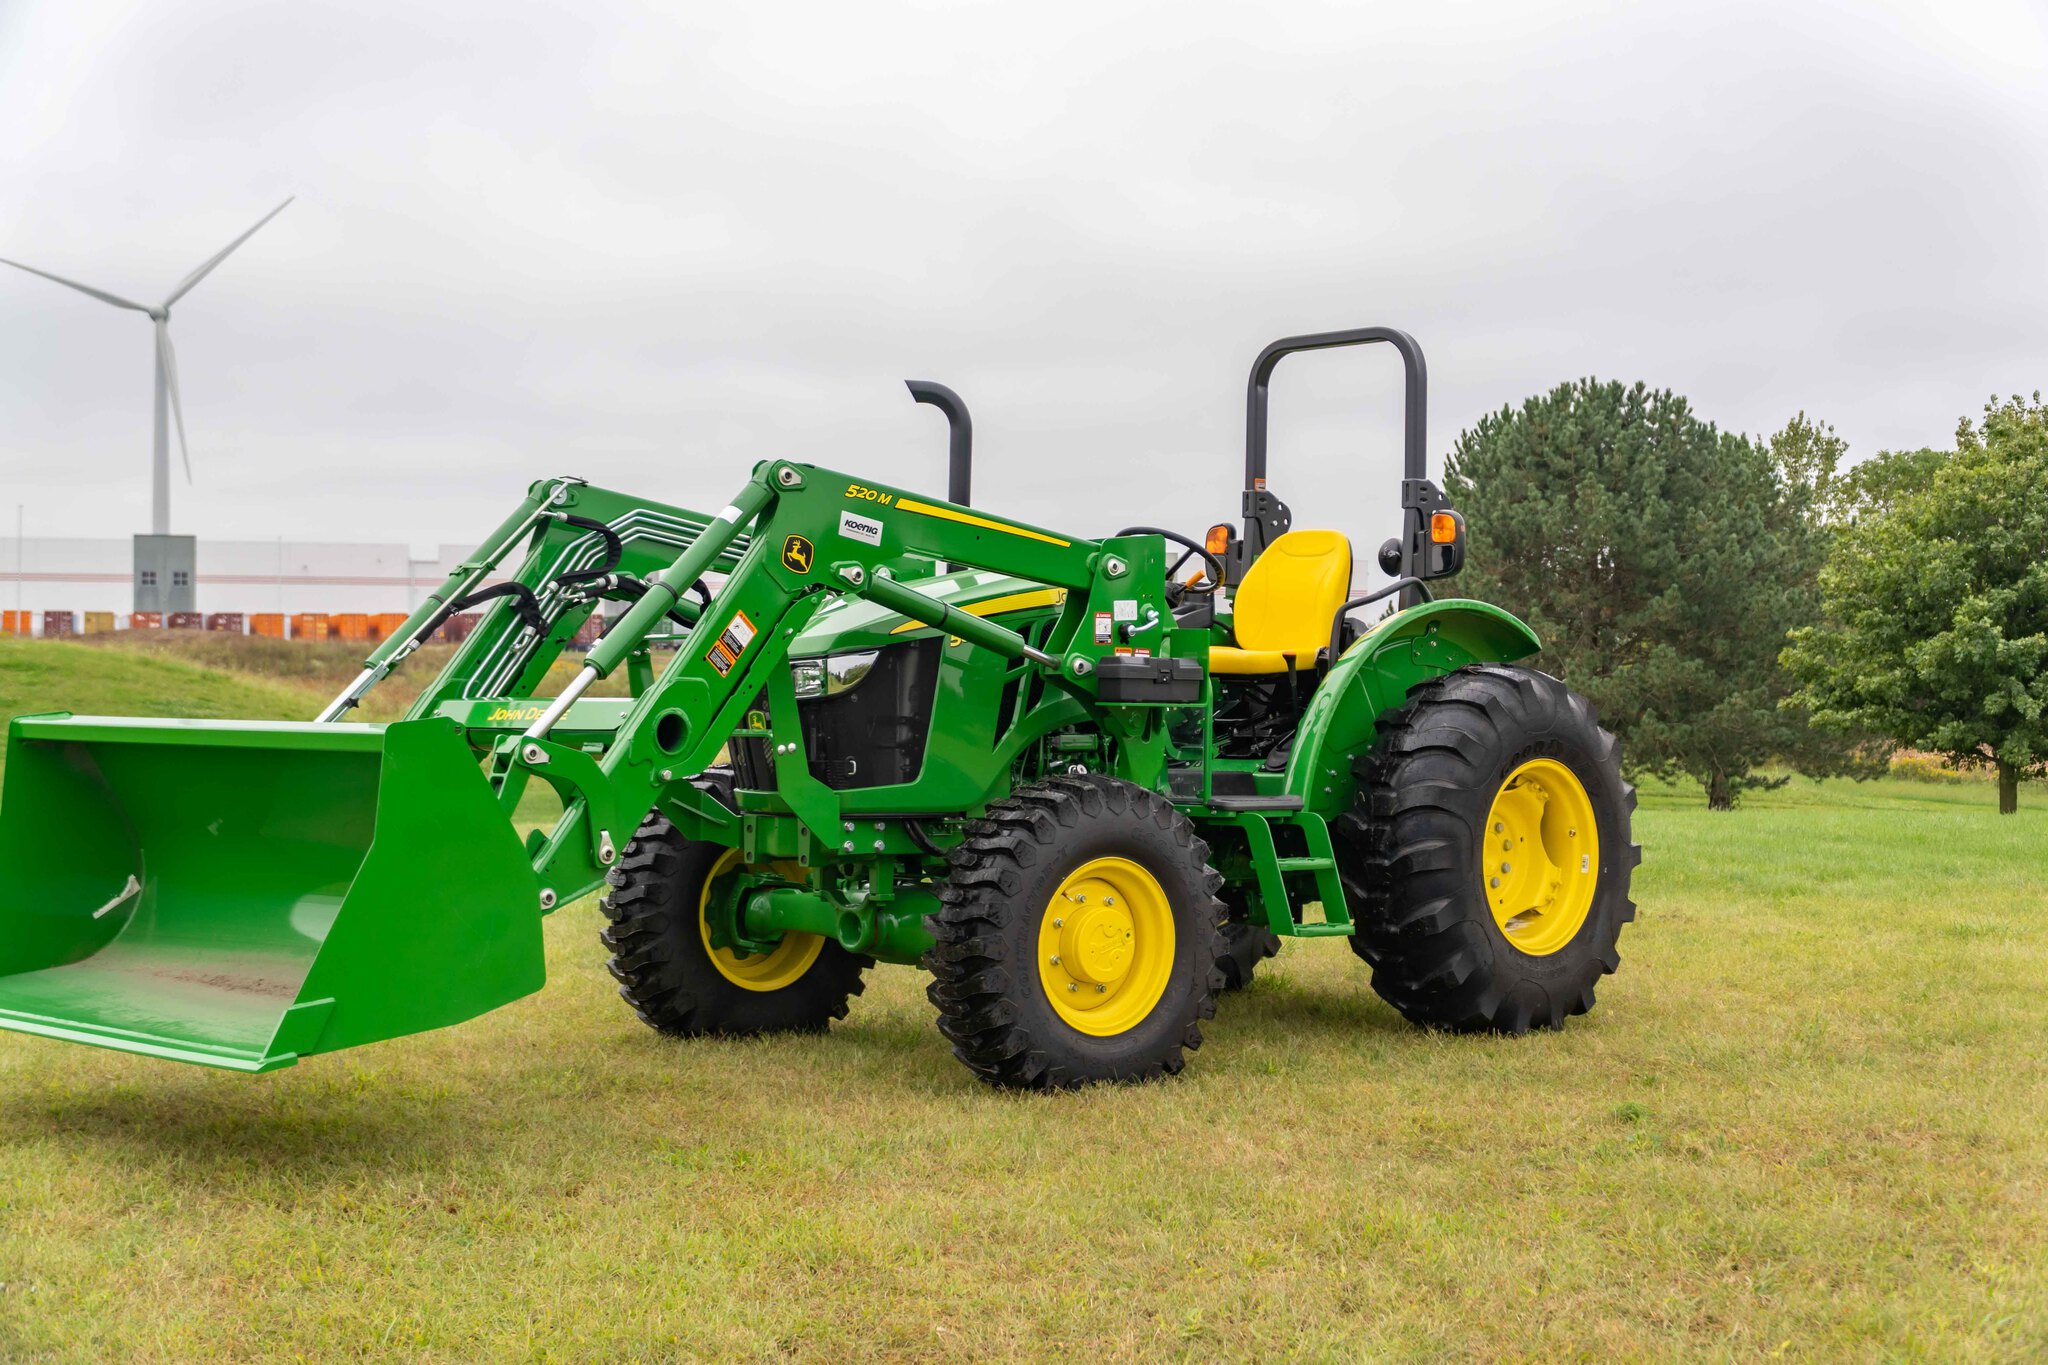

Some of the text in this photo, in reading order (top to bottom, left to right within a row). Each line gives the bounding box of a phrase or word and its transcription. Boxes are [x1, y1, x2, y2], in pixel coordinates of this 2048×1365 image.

[845, 484, 893, 505] 520 M
[487, 706, 572, 721] JOHN DEE
